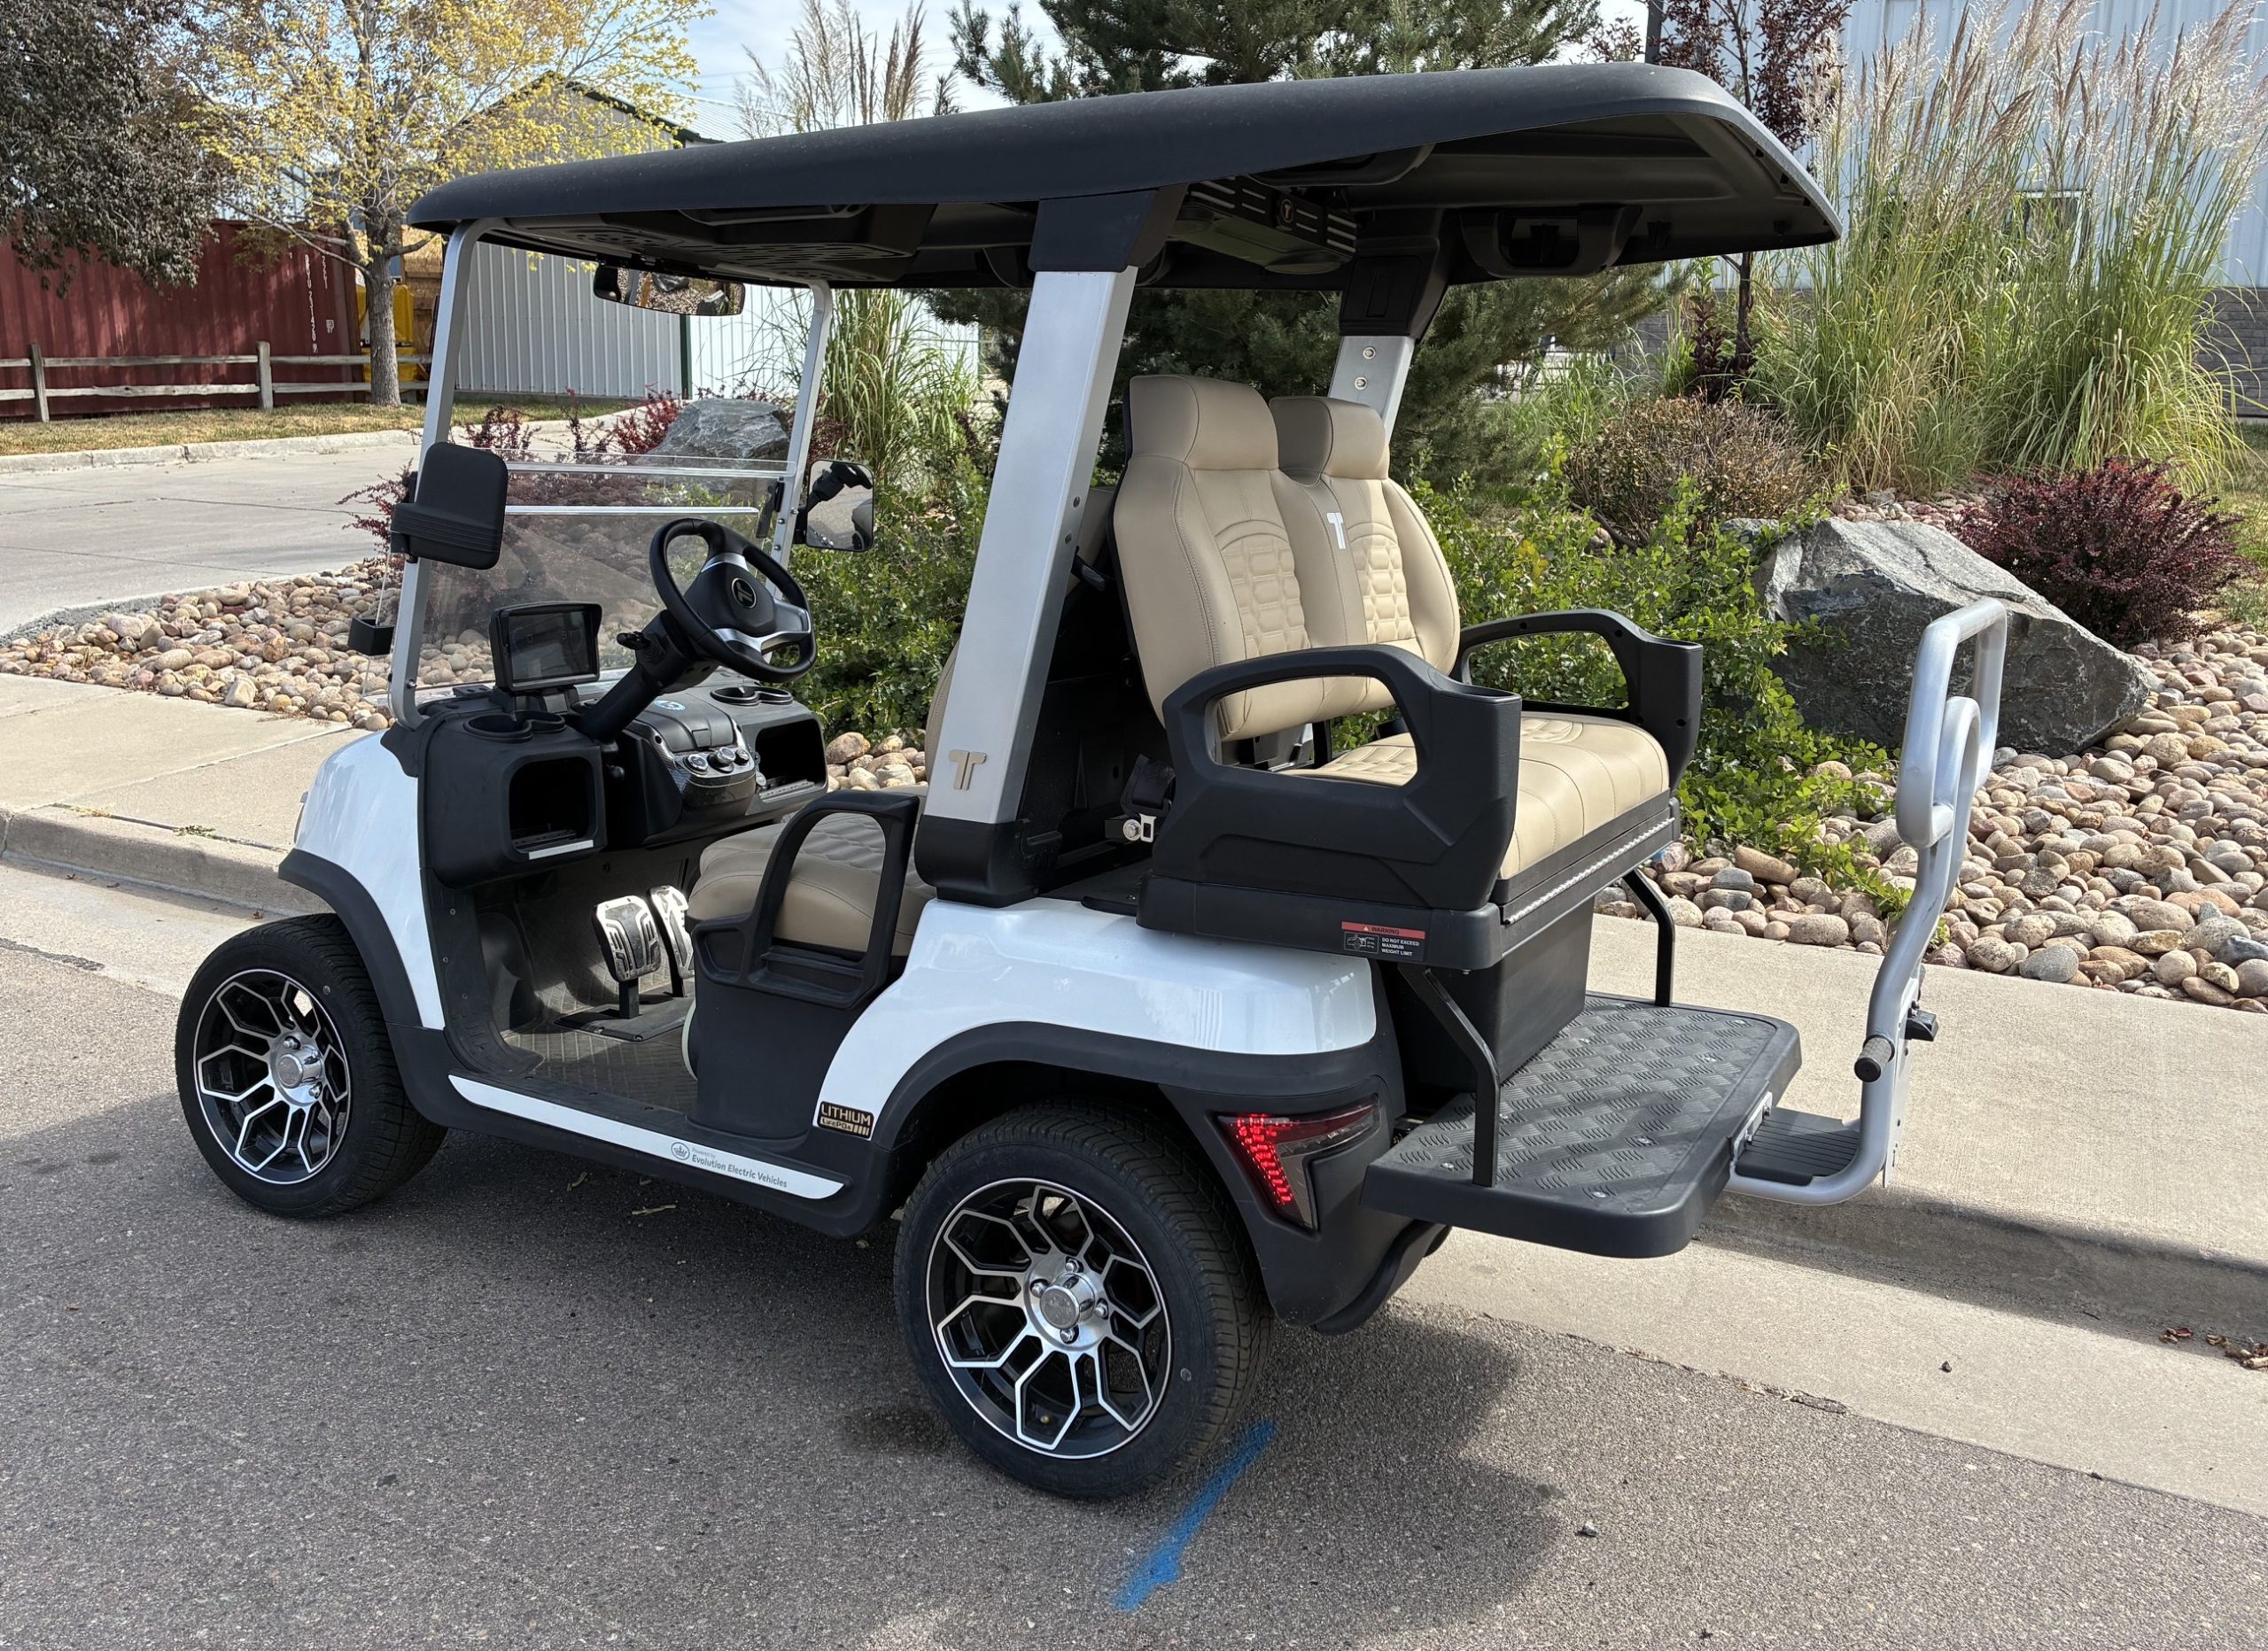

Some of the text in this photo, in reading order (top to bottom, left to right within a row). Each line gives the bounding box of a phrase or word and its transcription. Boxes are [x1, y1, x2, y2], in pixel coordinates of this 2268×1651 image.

[821, 1104, 871, 1127] LITHIUM
[692, 1147, 711, 1158] Powered
[692, 1155, 788, 1188] Evolution Electric Vehicles
